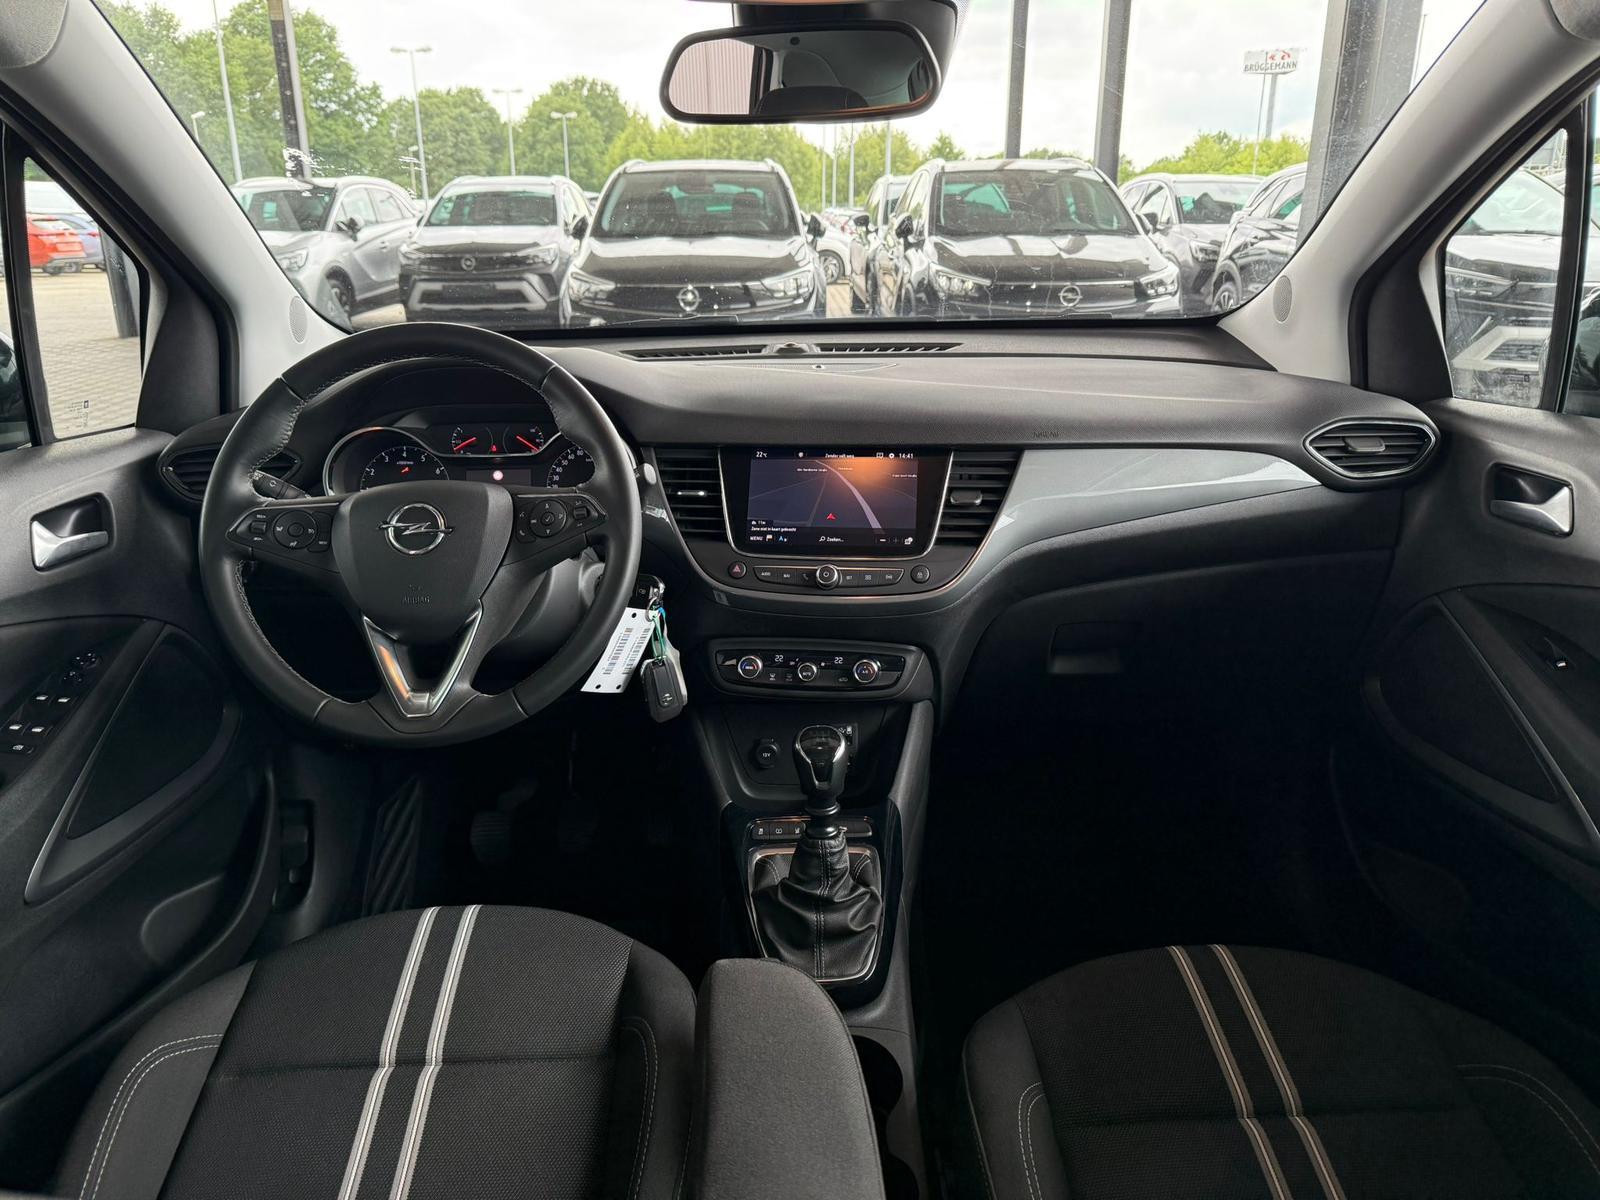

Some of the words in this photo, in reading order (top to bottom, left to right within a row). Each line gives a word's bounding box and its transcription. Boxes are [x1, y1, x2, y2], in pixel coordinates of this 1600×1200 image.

[1243, 61, 1297, 72] BRÜGGEMANN
[774, 654, 784, 662] 22
[834, 656, 844, 664] 22
